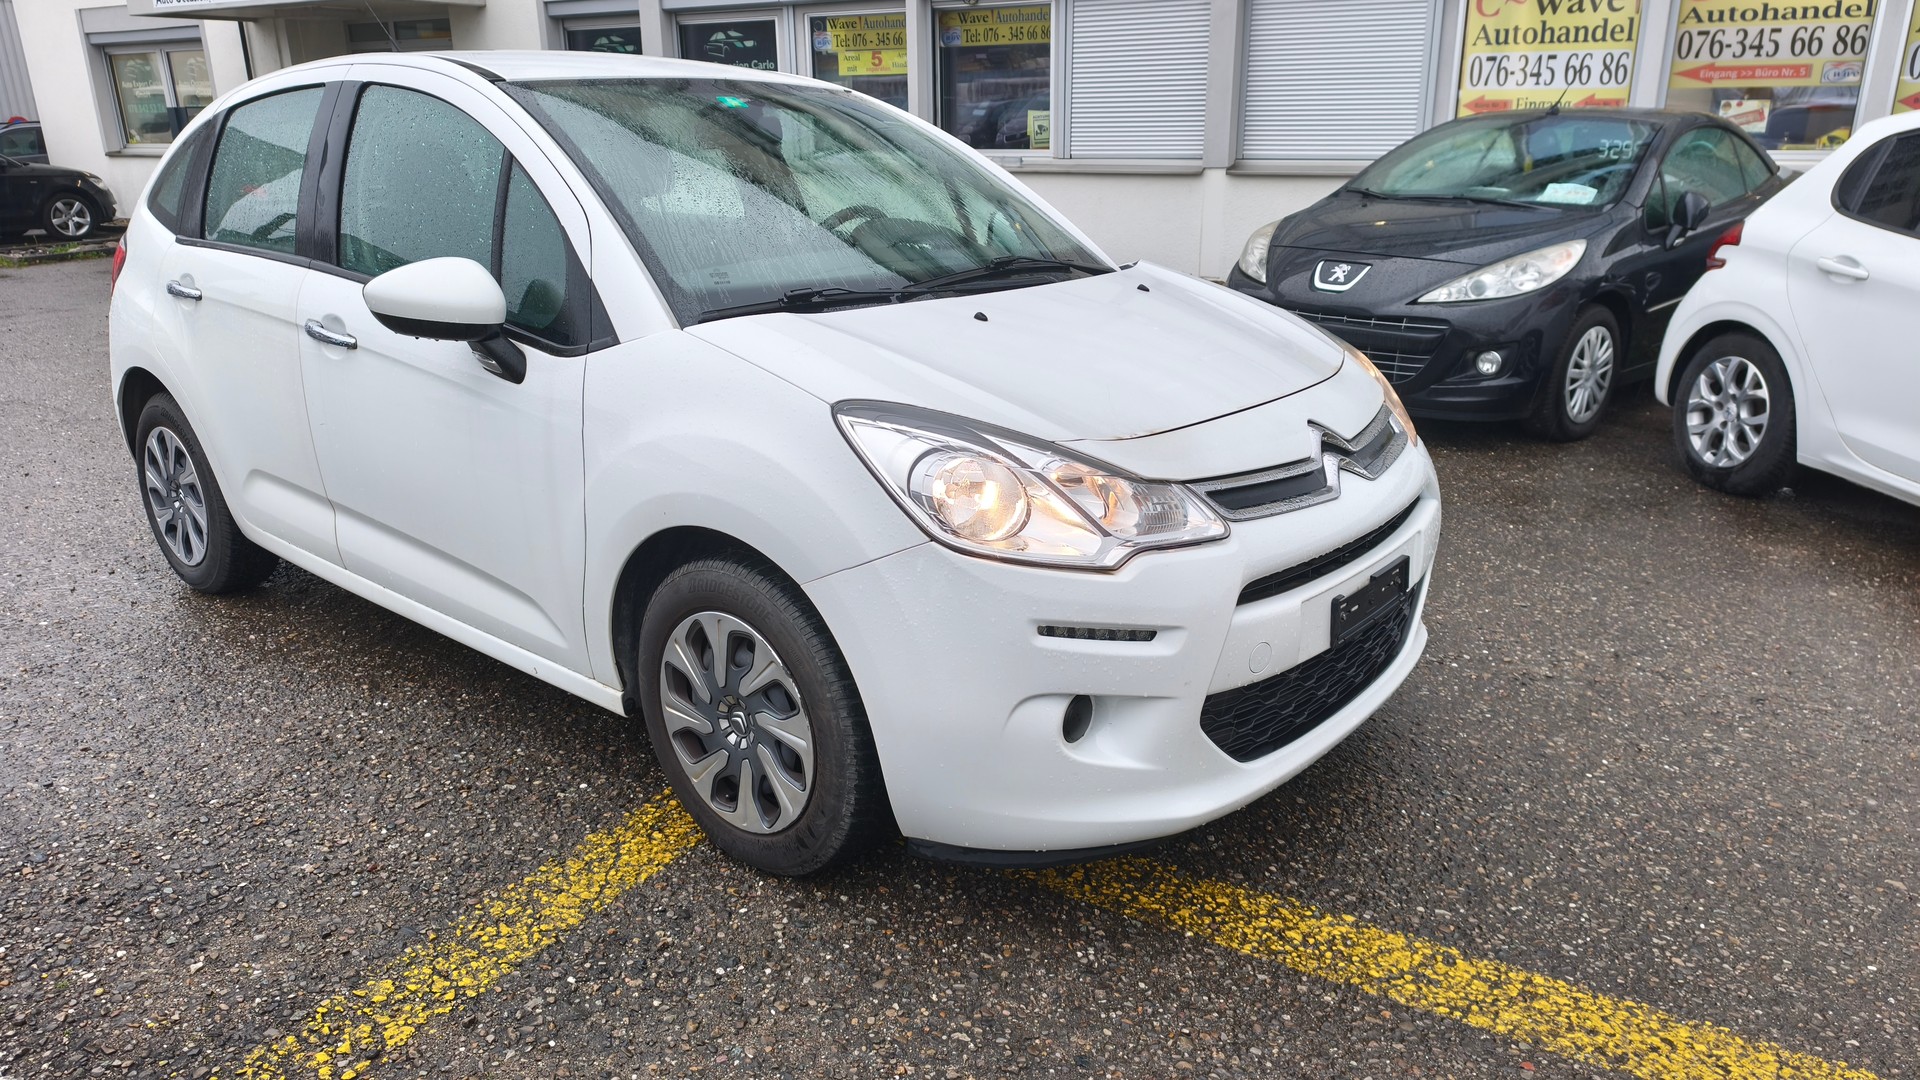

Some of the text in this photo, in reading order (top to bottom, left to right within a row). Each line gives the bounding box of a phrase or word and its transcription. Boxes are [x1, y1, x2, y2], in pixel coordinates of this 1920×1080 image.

[958, 12, 988, 24] Wave
[1680, 0, 1873, 24] Autohandel
[827, 18, 857, 29] Wave
[1472, 17, 1634, 46] Autohandel
[834, 34, 849, 47] Tel:
[852, 33, 867, 47] 076
[876, 32, 890, 46] 345
[893, 31, 903, 46] 66
[963, 27, 980, 43] Tel:
[983, 27, 999, 41] 076
[1008, 26, 1024, 41] 345
[1027, 25, 1037, 40] 66
[1041, 24, 1051, 39] 86
[1678, 24, 1869, 60] 076-345 66 86
[751, 60, 775, 69] Carlo
[872, 50, 882, 66] 5
[1469, 52, 1630, 87] 076-345 66 86
[1700, 69, 1738, 79] Eingang
[1755, 67, 1779, 77] Büro
[1781, 66, 1797, 76] Nr.
[1799, 65, 1807, 76] 5
[688, 578, 773, 620] BRIDGESTONE
